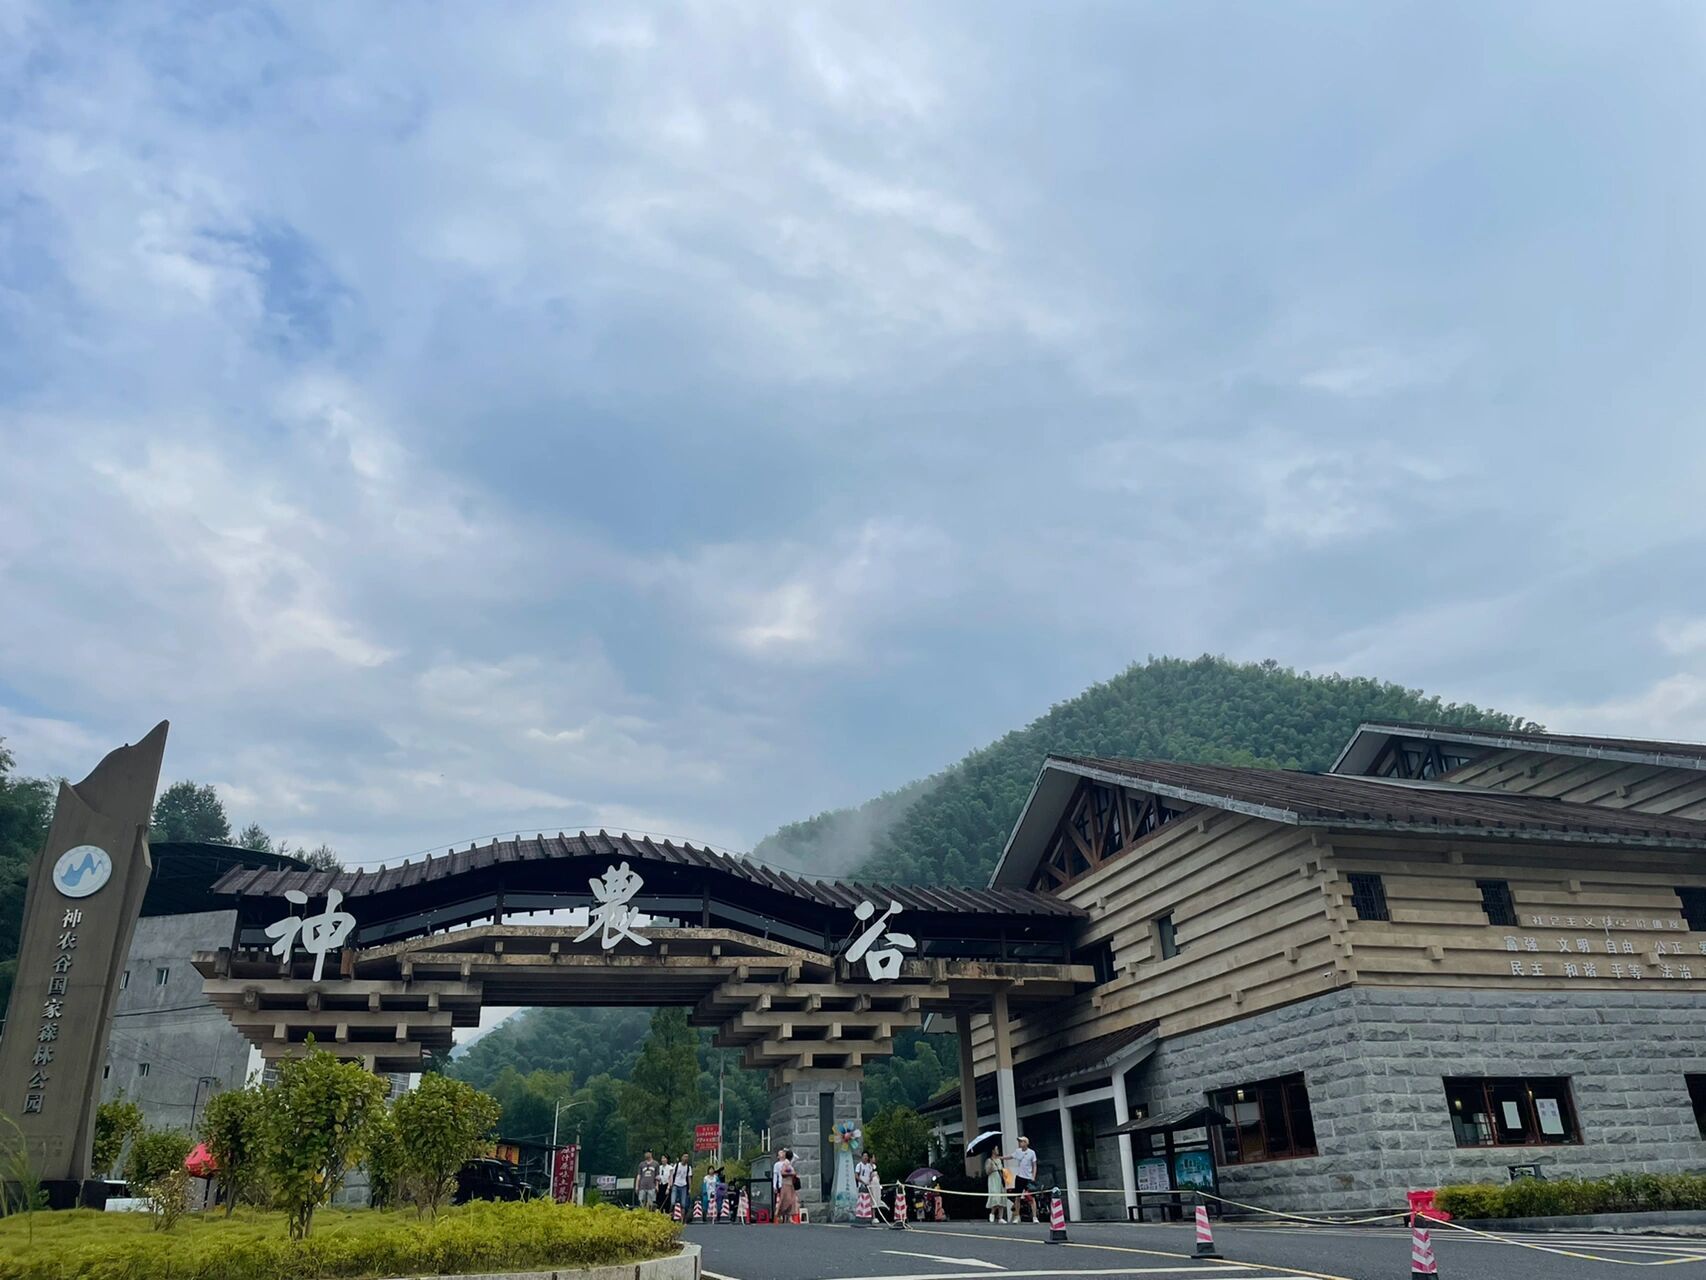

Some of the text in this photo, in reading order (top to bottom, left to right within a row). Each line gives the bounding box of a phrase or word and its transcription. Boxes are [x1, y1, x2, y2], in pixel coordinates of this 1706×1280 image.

[264, 861, 916, 982] 神農谷
[1503, 935, 1540, 952] 富强
[1556, 937, 1591, 953] 文明
[1605, 938, 1634, 954] 自由
[1654, 940, 1683, 955] 公正
[1510, 960, 1693, 979] 民主 和谐 平等 法治
[22, 908, 83, 1114] 神农谷国家森林公园
